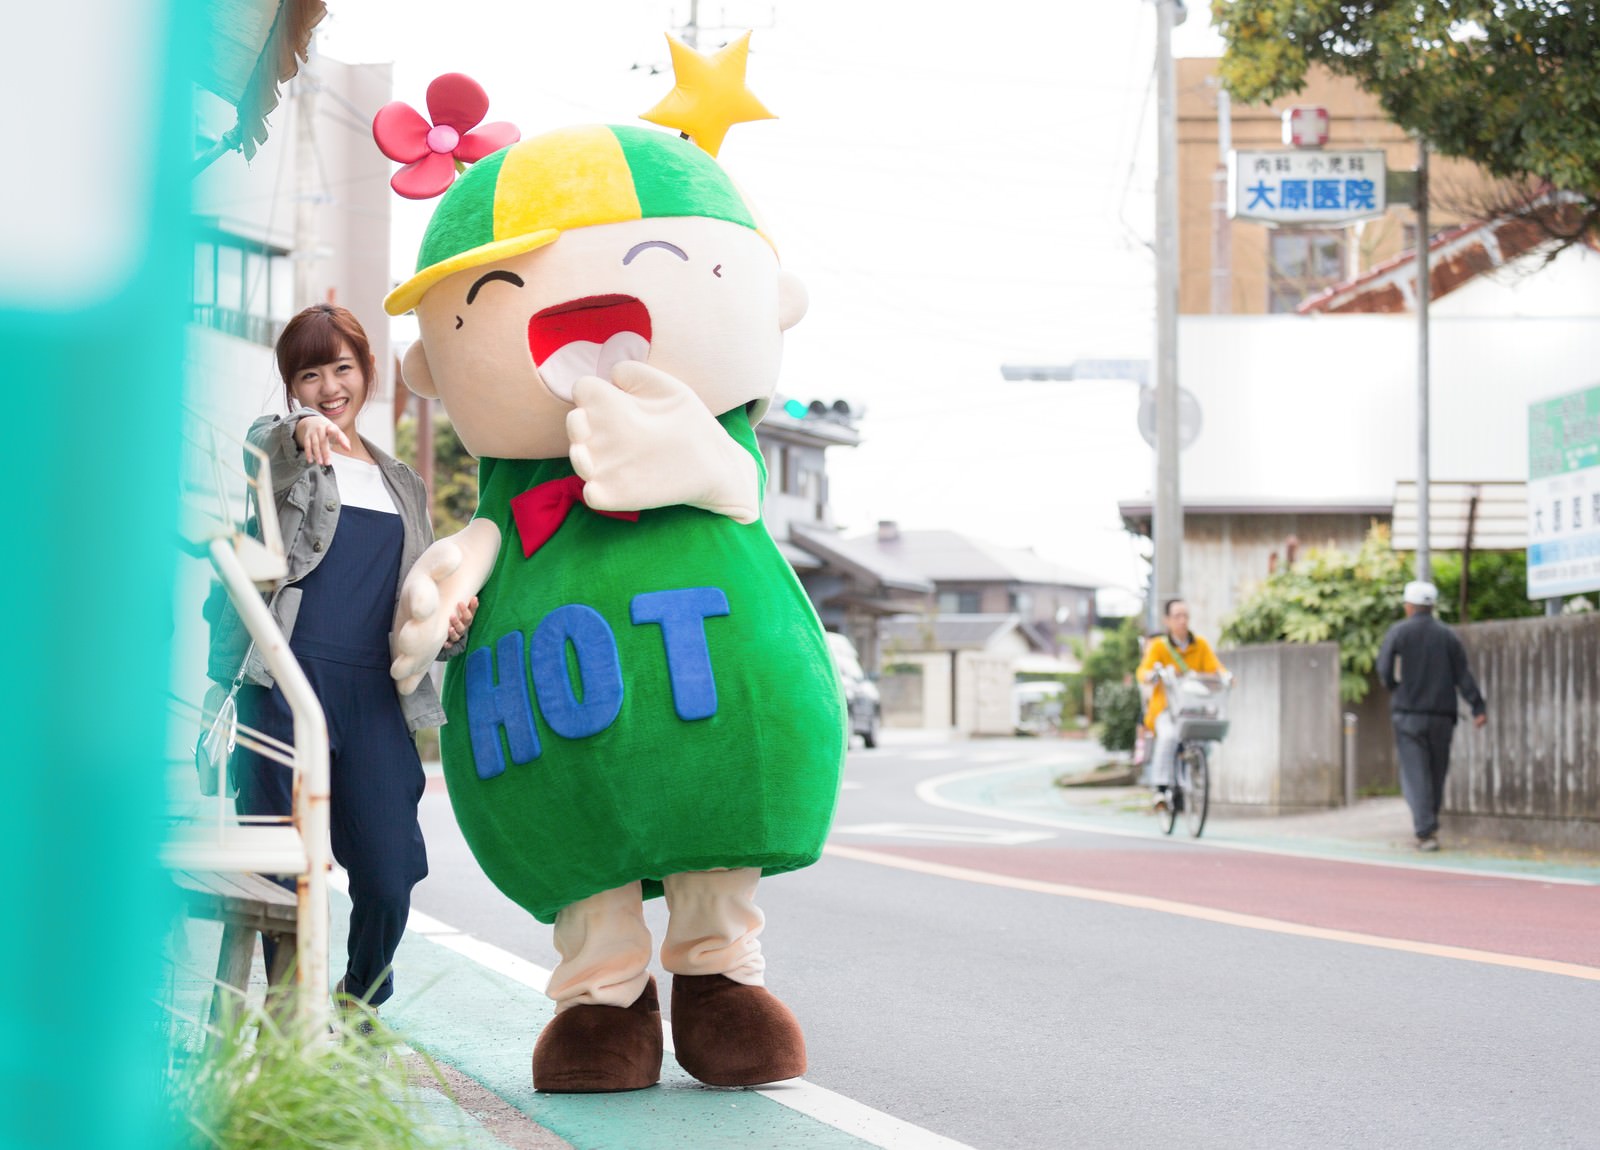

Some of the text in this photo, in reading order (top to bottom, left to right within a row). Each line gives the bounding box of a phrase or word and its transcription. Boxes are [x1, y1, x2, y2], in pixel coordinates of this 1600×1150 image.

[1247, 179, 1376, 210] 大原医院
[465, 586, 730, 780] HOT
